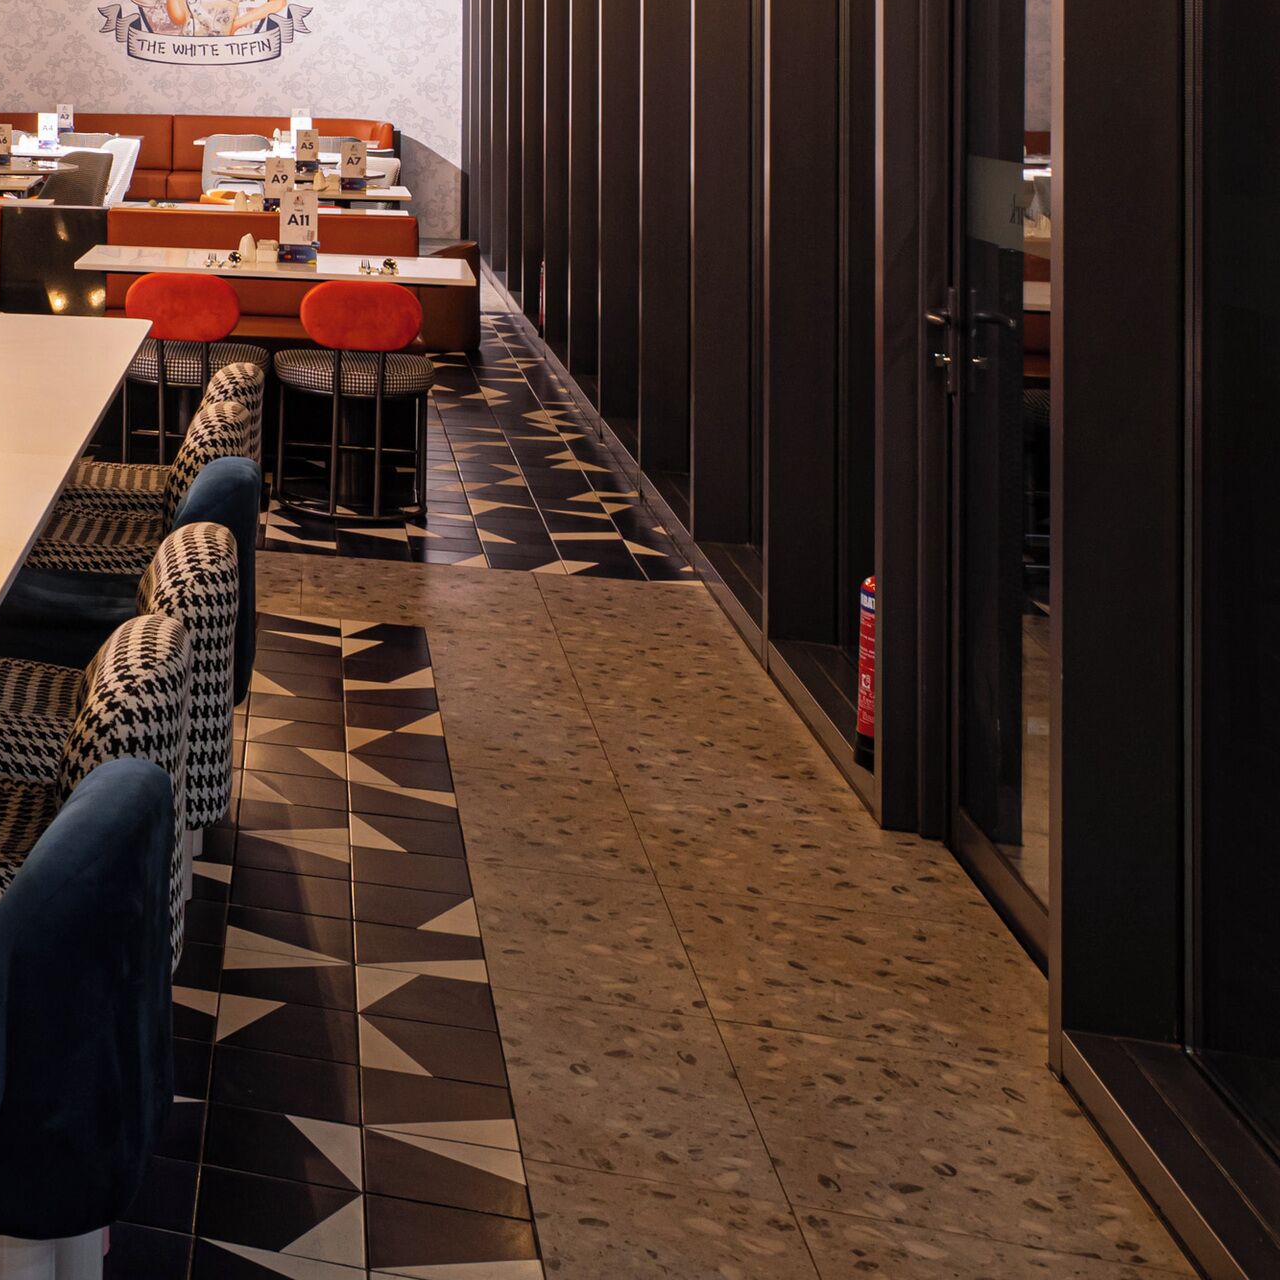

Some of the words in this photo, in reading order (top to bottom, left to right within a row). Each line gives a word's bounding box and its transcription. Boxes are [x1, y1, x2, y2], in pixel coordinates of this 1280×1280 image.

[137, 39, 166, 54] THE
[172, 43, 219, 57] WHITE
[225, 38, 272, 56] TIFFIN
[301, 142, 314, 150] A5
[346, 155, 361, 166] A7
[271, 173, 288, 184] A9
[287, 214, 309, 226] A11
